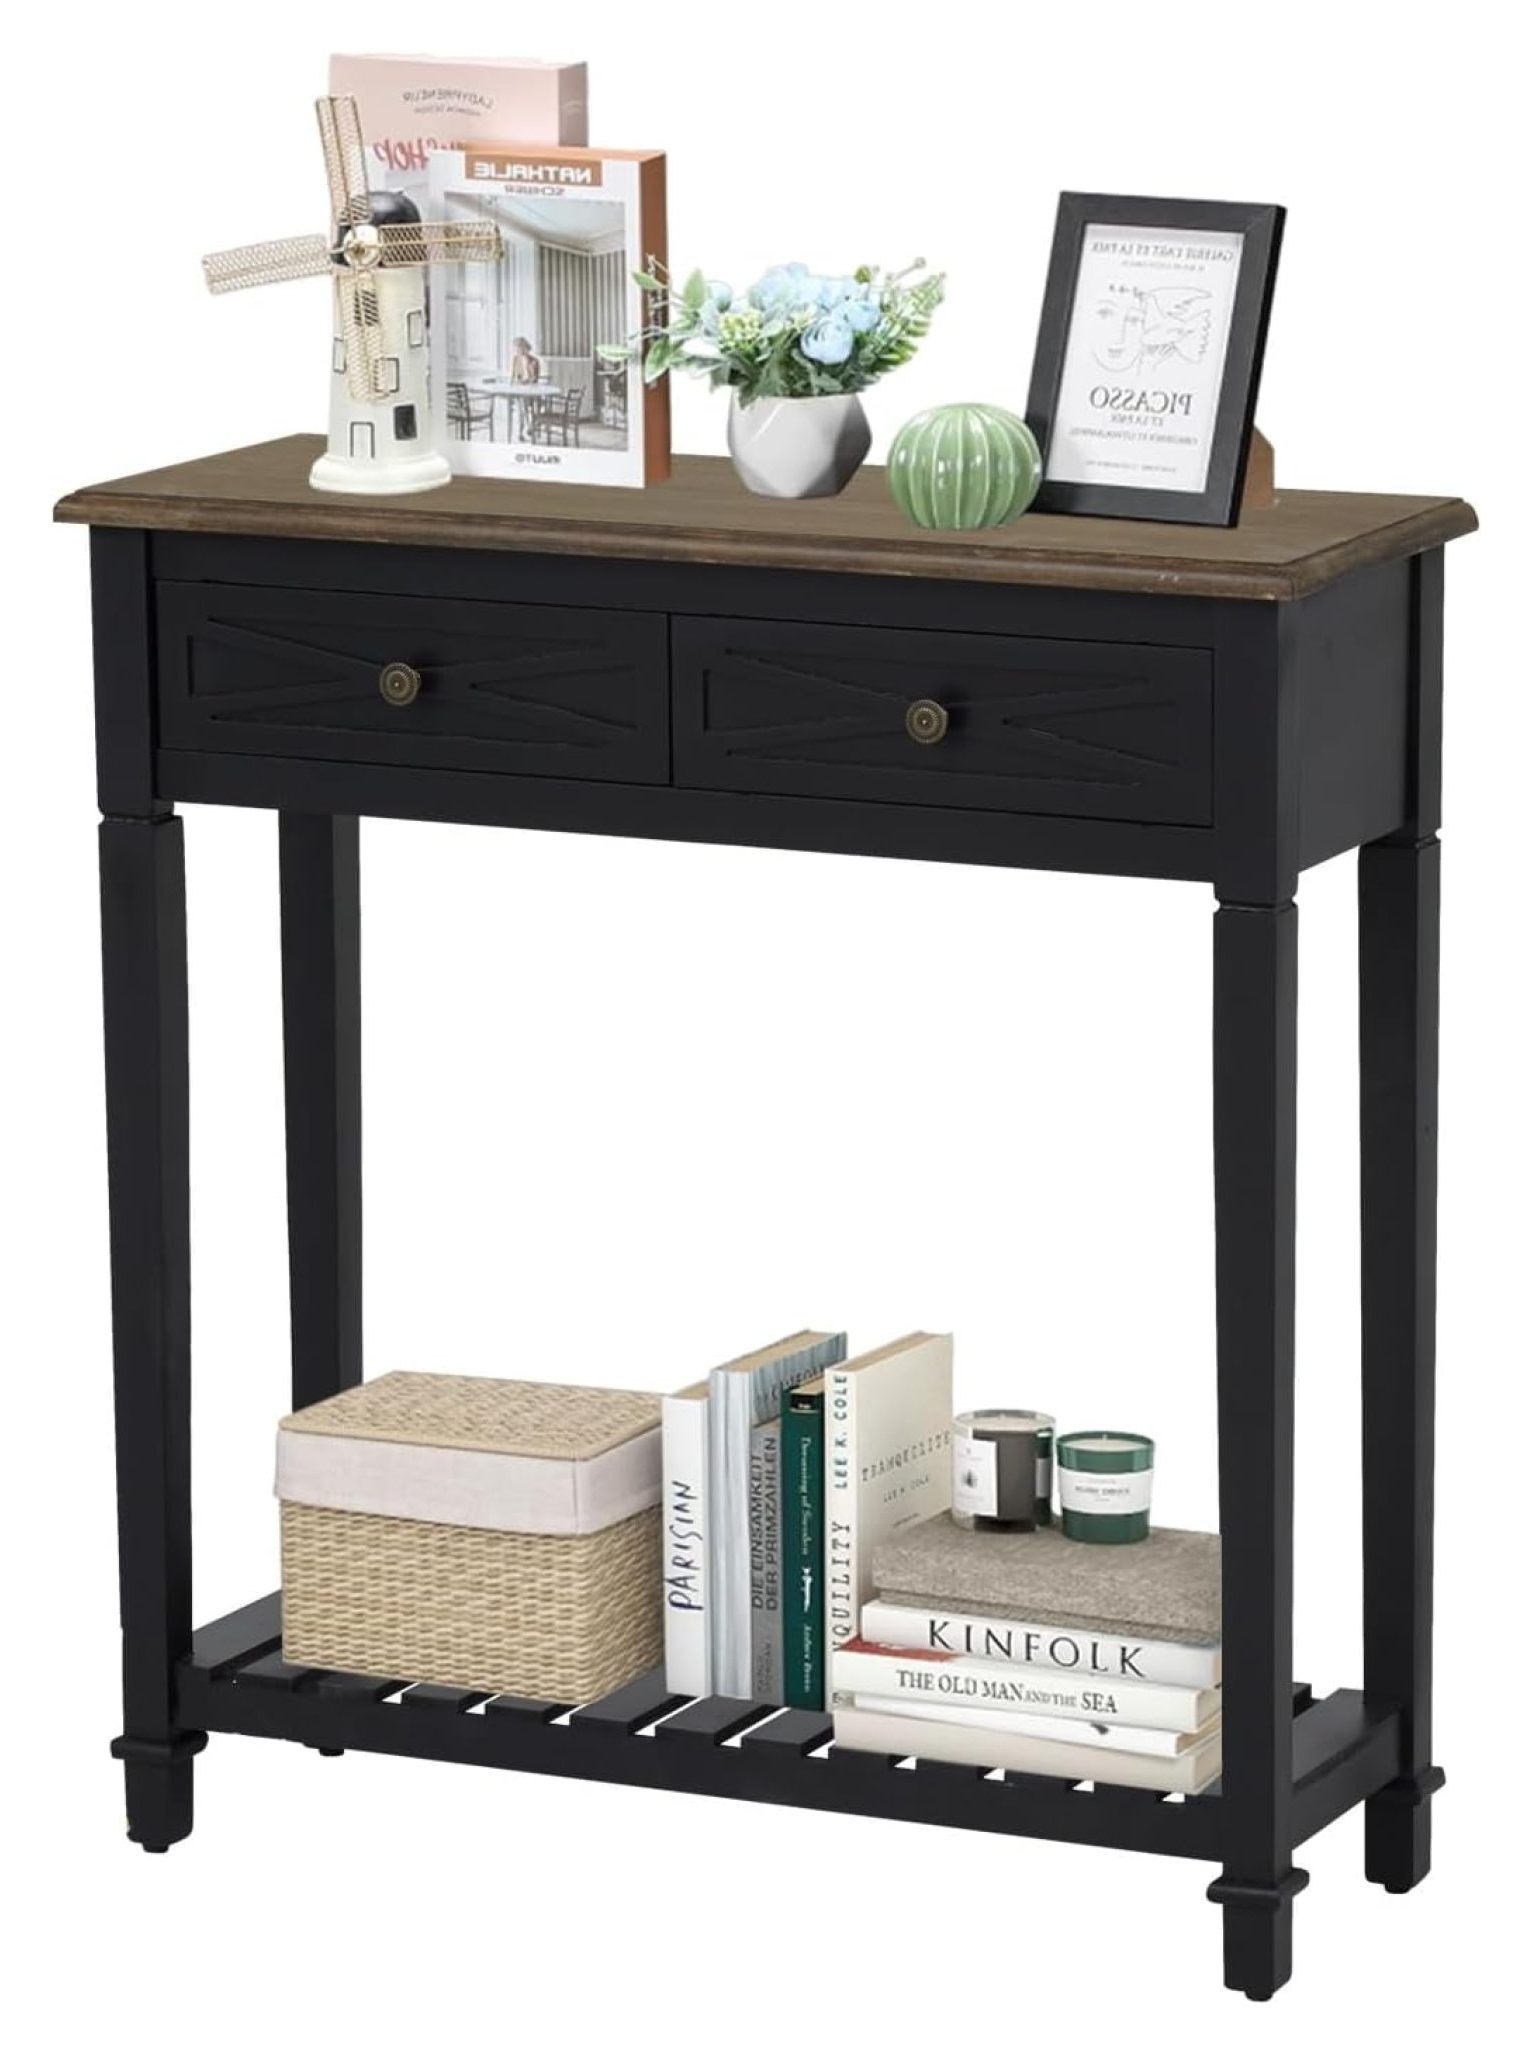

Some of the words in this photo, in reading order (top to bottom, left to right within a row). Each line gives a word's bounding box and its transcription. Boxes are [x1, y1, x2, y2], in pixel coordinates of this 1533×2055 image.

[833, 1375, 848, 1421] COLE
[834, 1458, 848, 1489] LEE
[750, 1455, 764, 1572] EINSAMKEIT
[764, 1437, 778, 1564] PRIMZAHLEN
[664, 1480, 704, 1611] PARISIAN
[751, 1574, 764, 1610] DIE
[765, 1570, 778, 1611] DER
[928, 1619, 1147, 1678] KINFOLK
[896, 1669, 935, 1691] THE
[938, 1673, 977, 1696] OLD
[981, 1679, 1025, 1701] MAN
[1025, 1689, 1050, 1704] AND
[1050, 1692, 1077, 1707] THE
[1080, 1691, 1118, 1714] SEA
